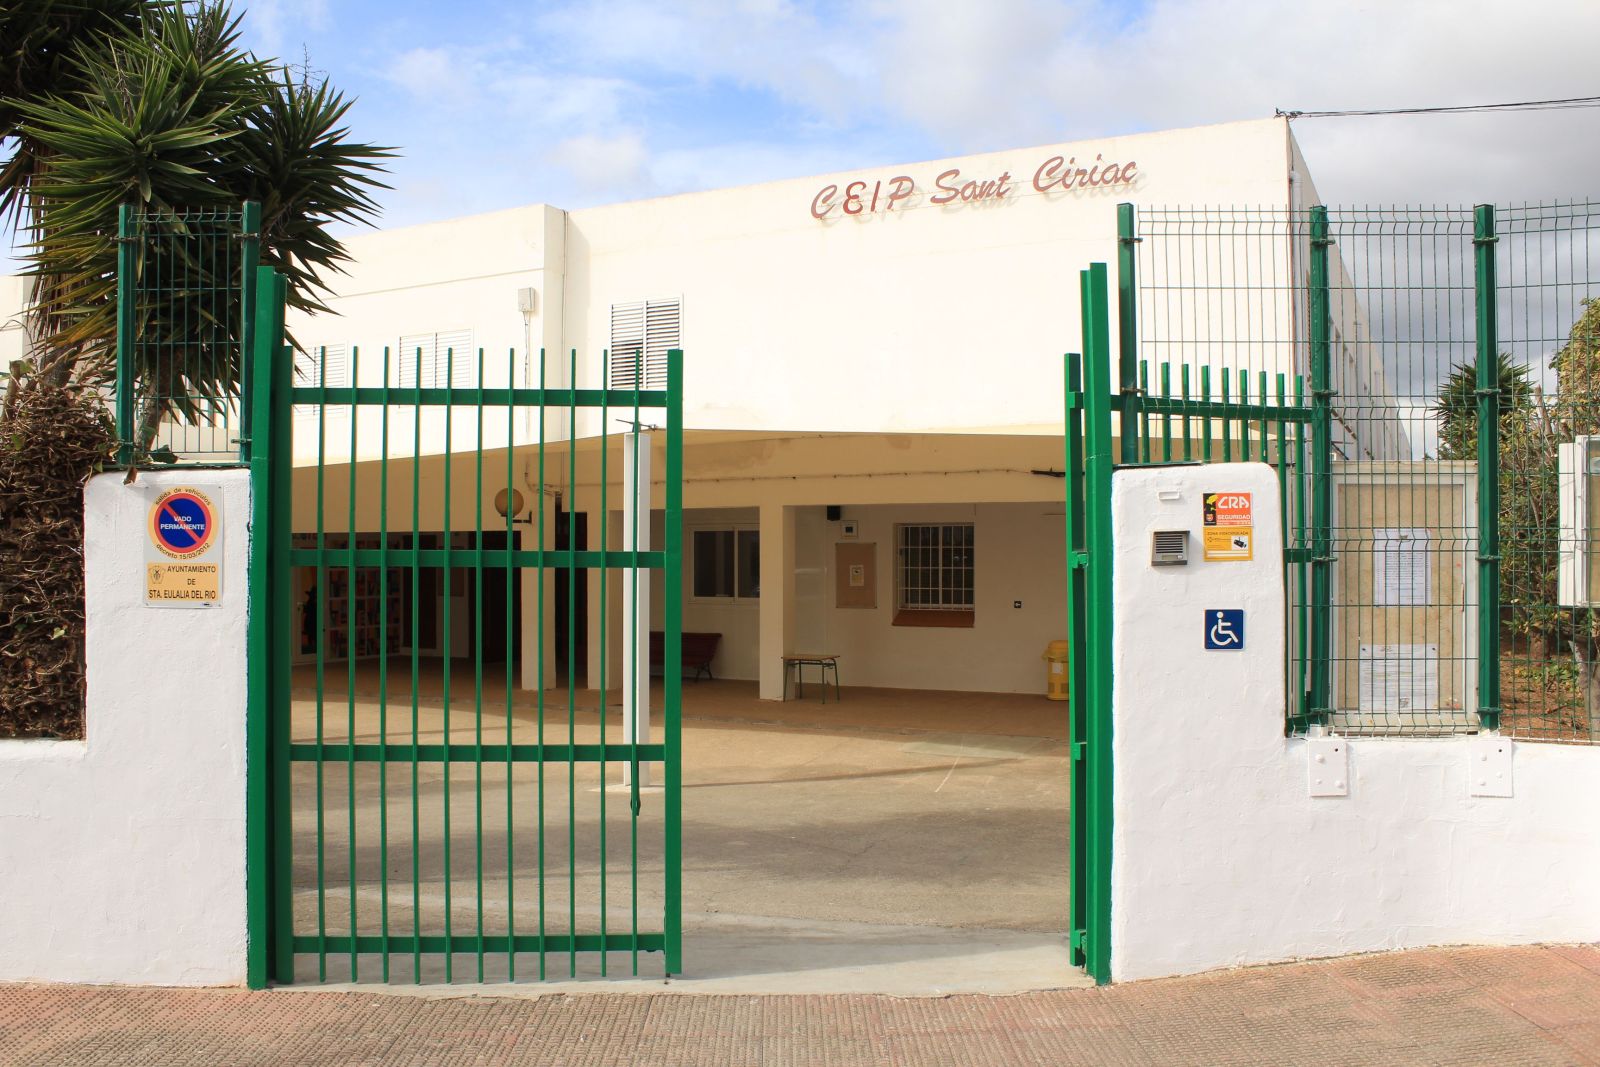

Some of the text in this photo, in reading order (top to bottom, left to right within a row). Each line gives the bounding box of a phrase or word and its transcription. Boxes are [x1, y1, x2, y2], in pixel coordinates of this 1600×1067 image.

[811, 153, 1138, 219] CEIP Sant Ciriac
[1218, 496, 1250, 509] CRA
[156, 542, 211, 560] decreto 15/03/2012
[167, 565, 217, 573] AYUNTAMIENTO
[187, 578, 196, 586] DE
[148, 589, 216, 600] STA. EULALIA DEL RIO
